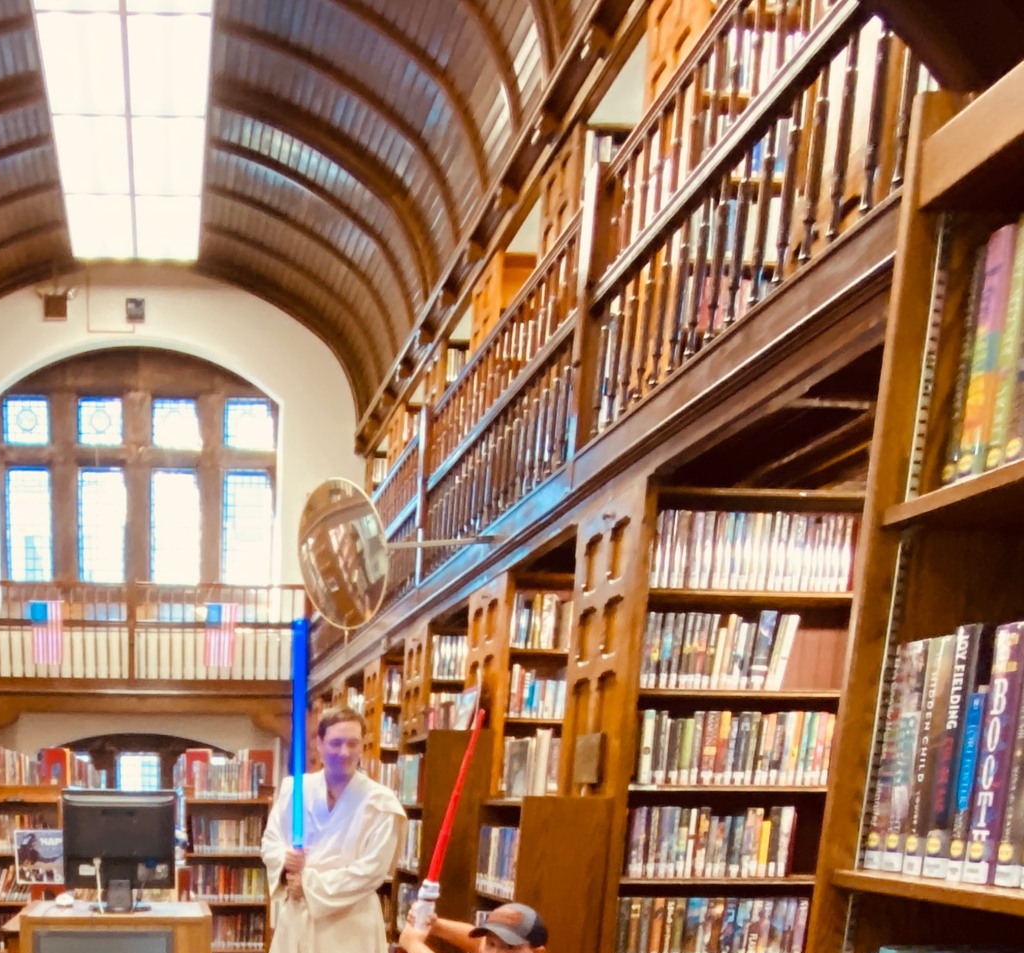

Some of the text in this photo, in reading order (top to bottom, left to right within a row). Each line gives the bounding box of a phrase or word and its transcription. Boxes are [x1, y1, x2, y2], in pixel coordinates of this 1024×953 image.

[946, 630, 970, 730] JOY FIELDING
[917, 736, 929, 782] CHILD
